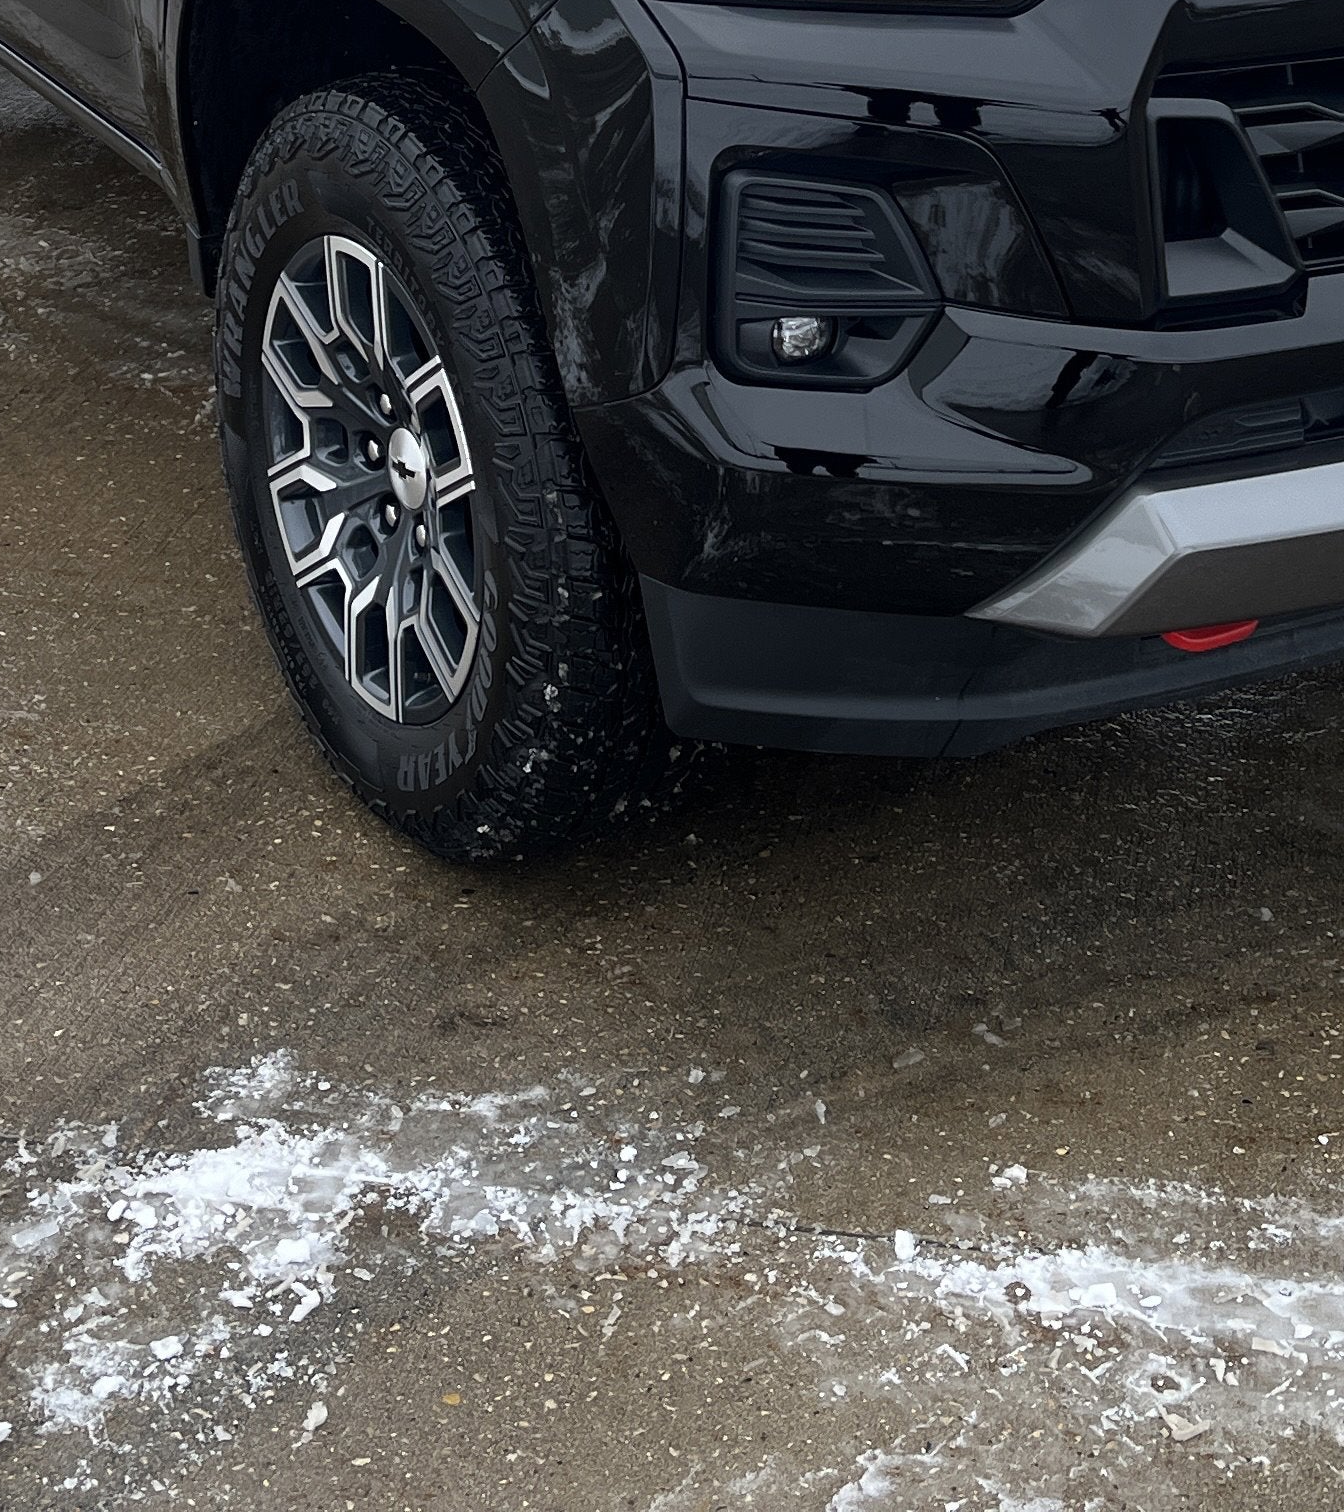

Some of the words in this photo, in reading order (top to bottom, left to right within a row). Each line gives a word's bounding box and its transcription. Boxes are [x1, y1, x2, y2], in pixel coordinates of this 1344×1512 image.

[222, 178, 305, 399] WRANGLER
[366, 214, 446, 346] TERRITORY
[397, 569, 498, 792] GOODYEAR
